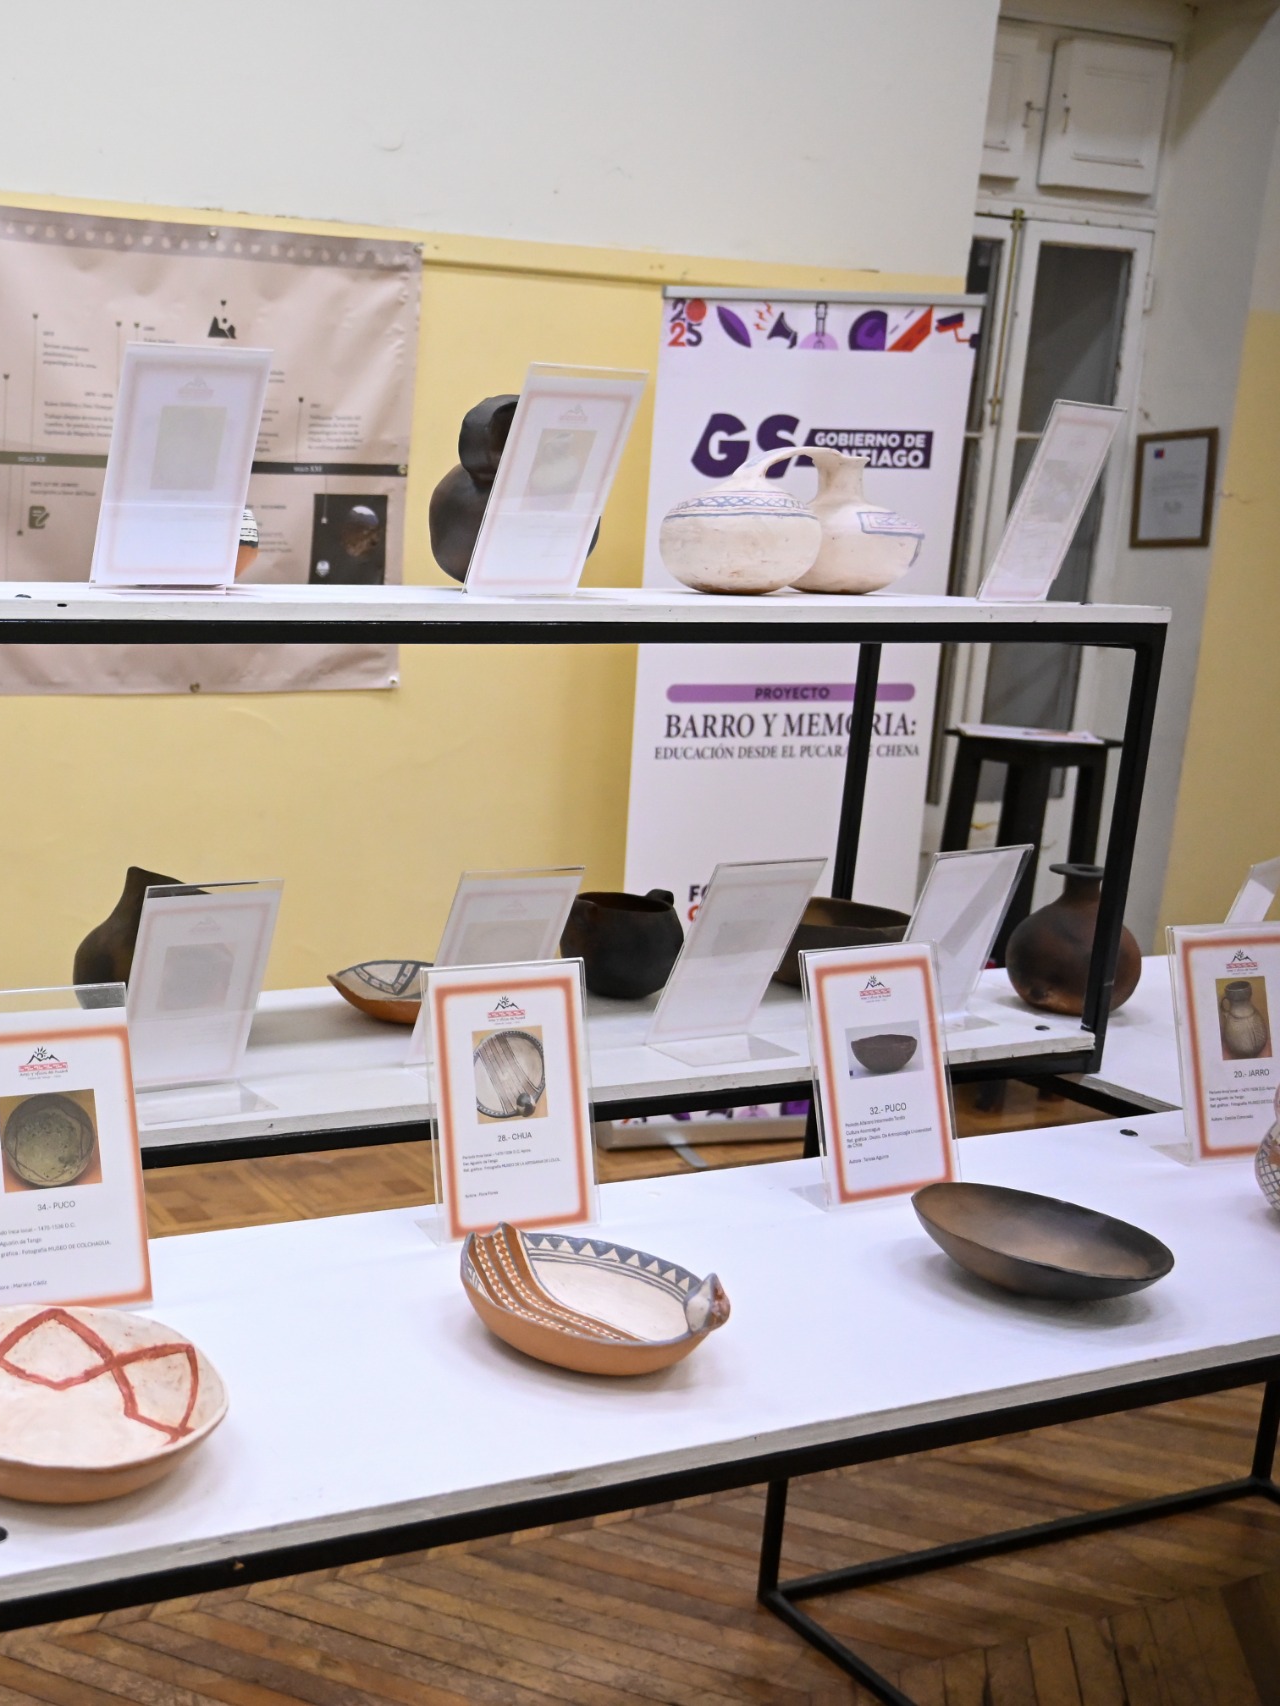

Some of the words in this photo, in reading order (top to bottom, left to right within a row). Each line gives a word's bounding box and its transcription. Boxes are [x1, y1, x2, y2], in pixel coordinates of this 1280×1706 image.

[691, 413, 800, 479] GS
[814, 431, 899, 448] GOBIERNO
[904, 433, 926, 448] DE
[754, 687, 830, 700] PROYECTO
[664, 713, 755, 739] BARRO
[762, 713, 778, 738] Y
[654, 743, 735, 761] EDUCACIÓN
[737, 745, 777, 760] DESDE
[781, 745, 796, 759] EL
[876, 743, 920, 757] CHENA
[1249, 1068, 1270, 1077] JARRO
[870, 1106, 884, 1116] 32.-
[885, 1102, 907, 1113] PUCO
[512, 1131, 533, 1141] CHUA
[37, 1203, 52, 1212] 34.-
[53, 1200, 76, 1210] PUCO
